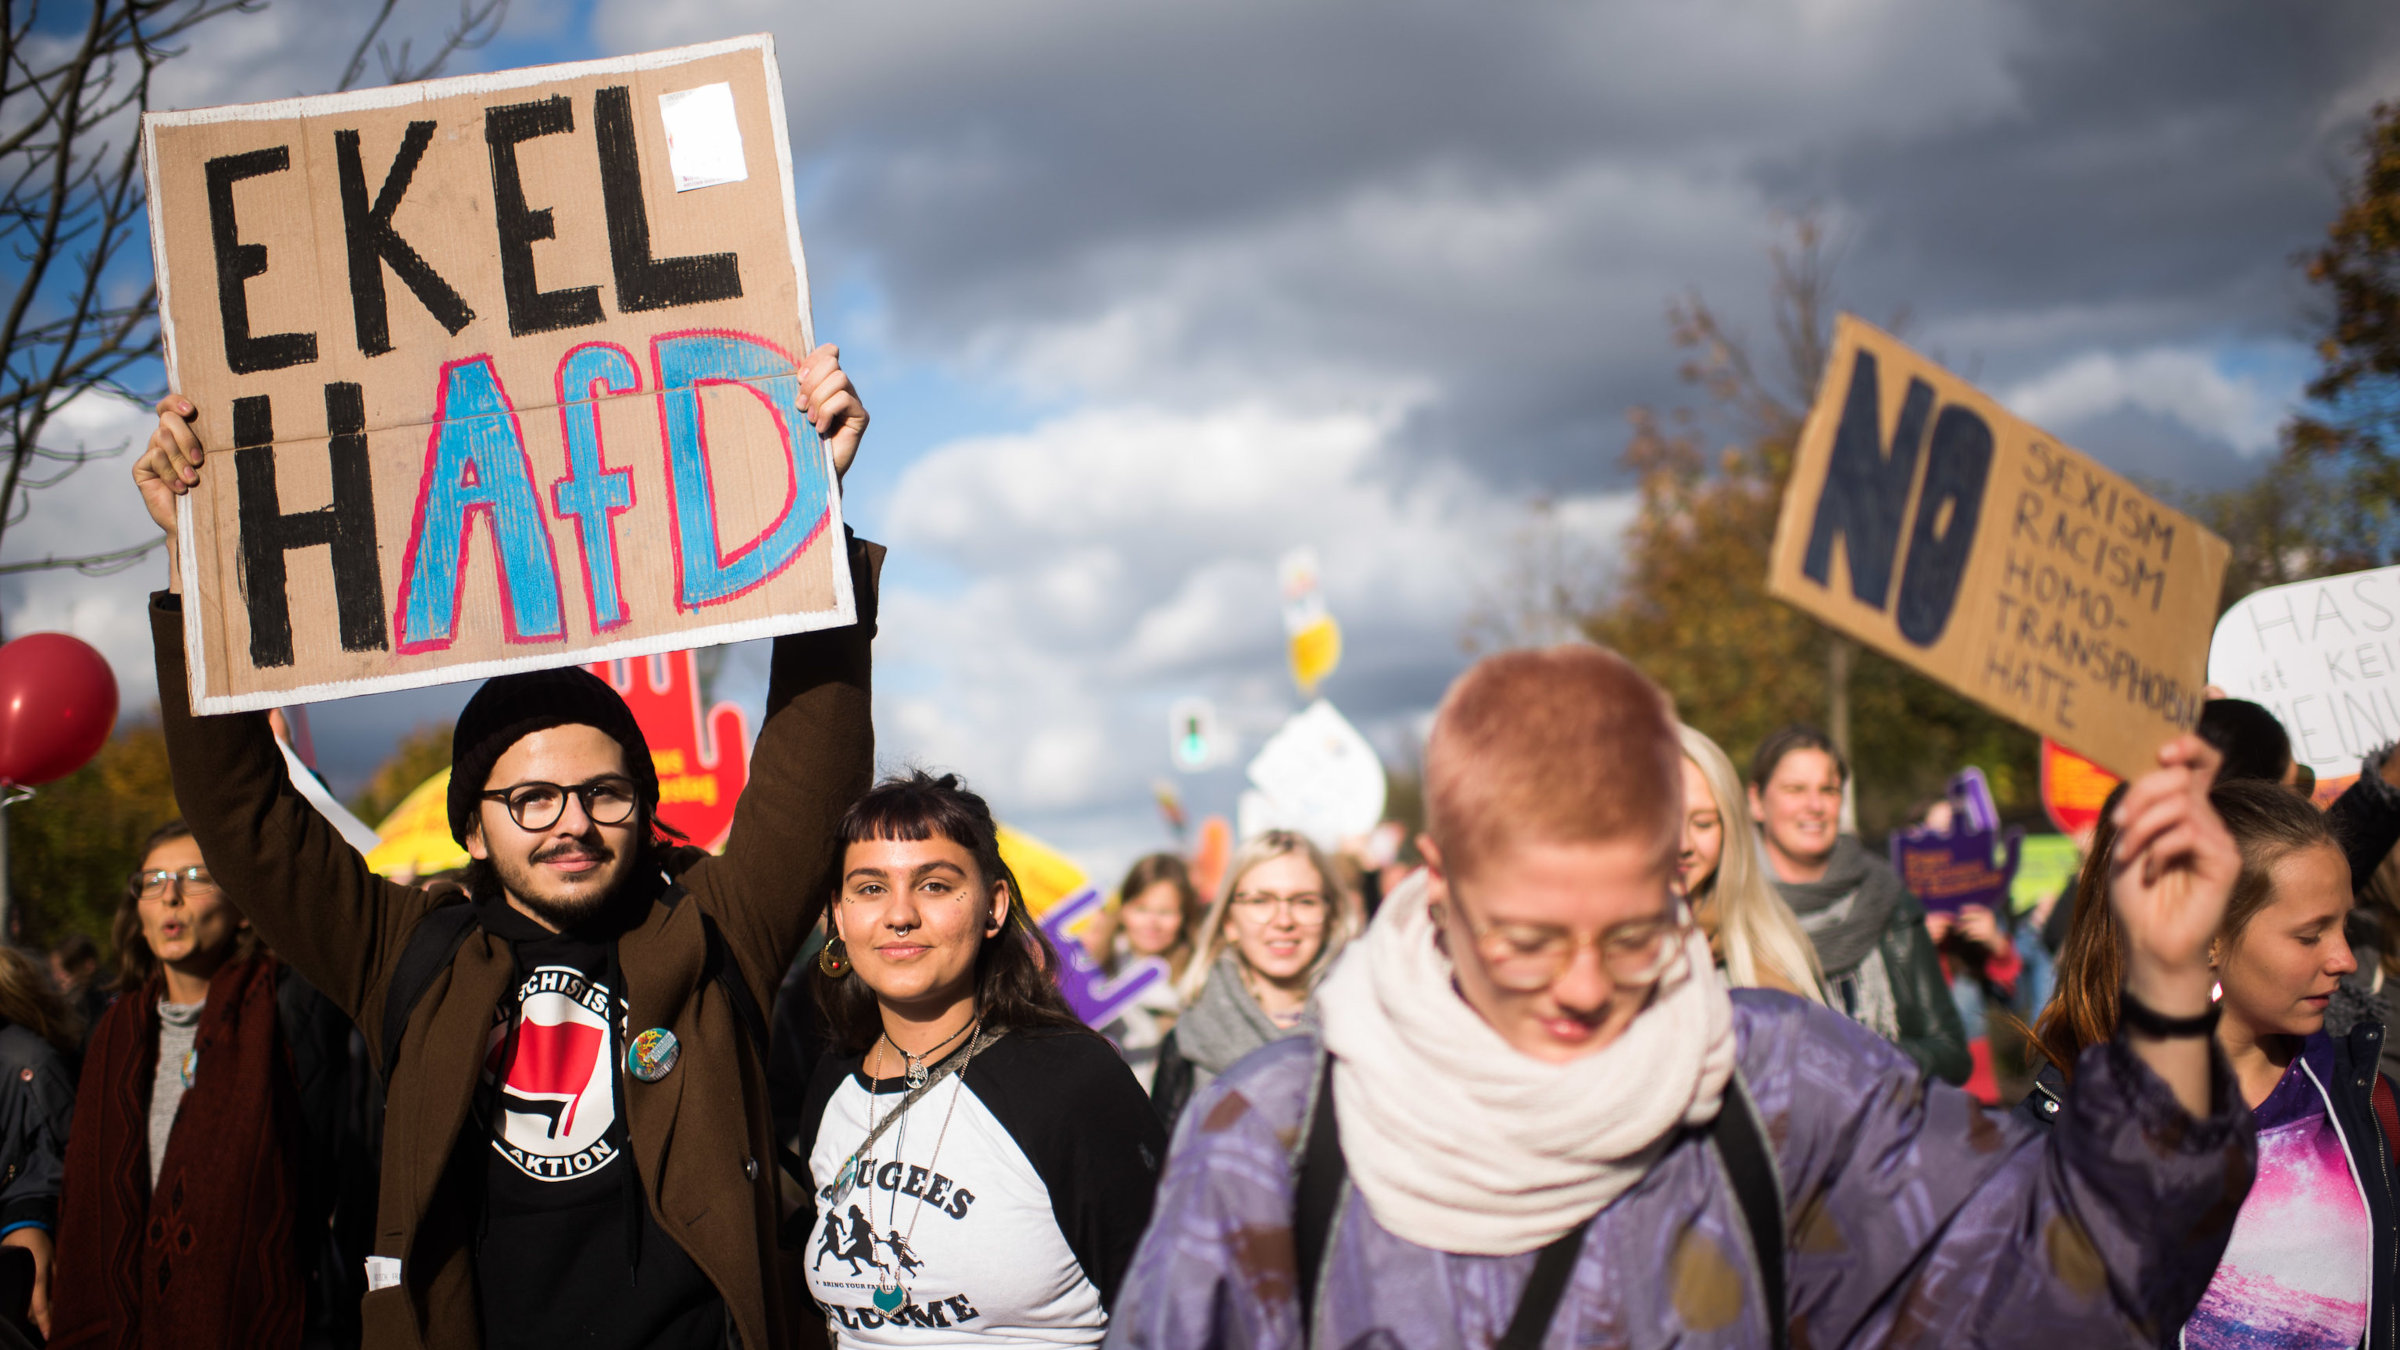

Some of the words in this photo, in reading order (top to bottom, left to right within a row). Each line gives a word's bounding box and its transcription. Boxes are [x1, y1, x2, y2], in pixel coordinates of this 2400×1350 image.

[205, 85, 743, 375] EKEL
[233, 328, 831, 670] HAfD
[1803, 345, 1995, 650] NO
[2021, 439, 2176, 565] SEXISM
[2003, 544, 2130, 631] HOMO-
[2012, 488, 2167, 614] RACISM
[2247, 573, 2400, 653] HAS
[1983, 640, 2079, 730] HATE
[2324, 640, 2400, 686] KEI
[509, 1138, 613, 1177] AKTION
[823, 1280, 845, 1288] BRING
[845, 1282, 866, 1290] YOUR
